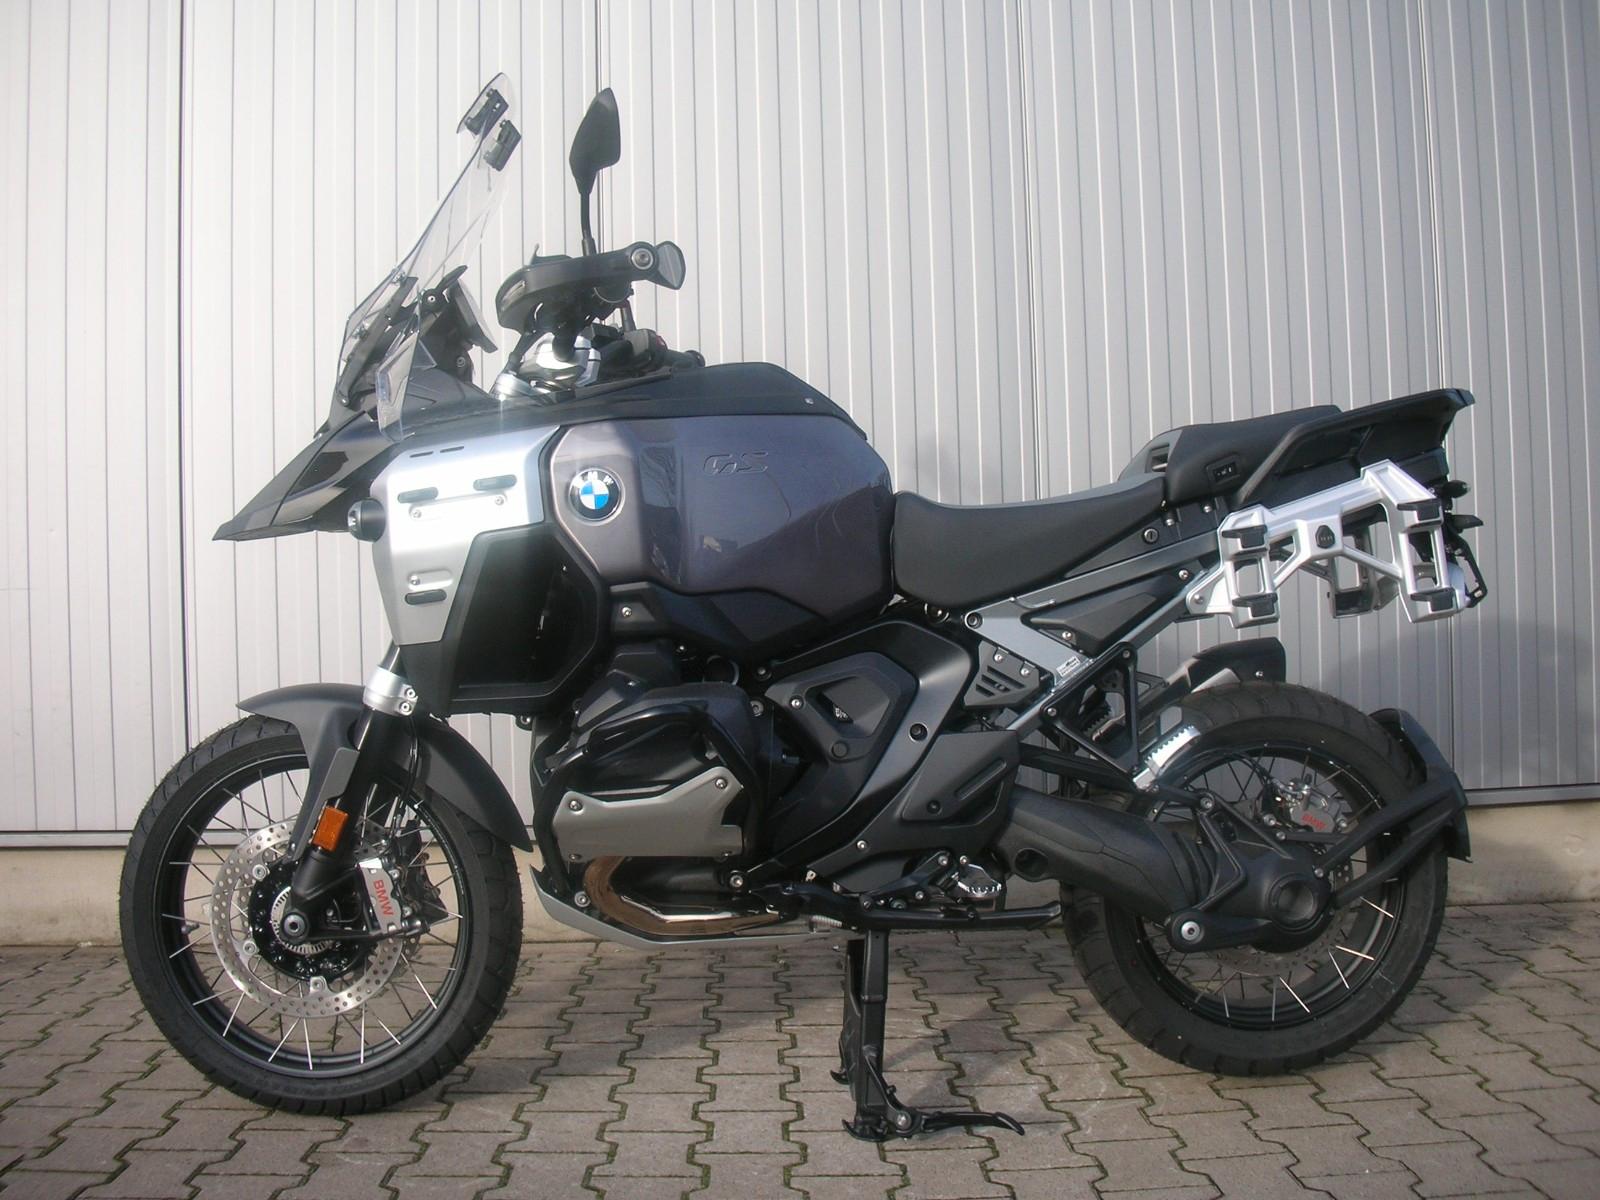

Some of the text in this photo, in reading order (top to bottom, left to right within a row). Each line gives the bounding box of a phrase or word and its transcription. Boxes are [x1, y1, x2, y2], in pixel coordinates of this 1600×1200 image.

[703, 452, 769, 475] GS
[571, 470, 614, 488] MW
[373, 879, 394, 916] BMW
